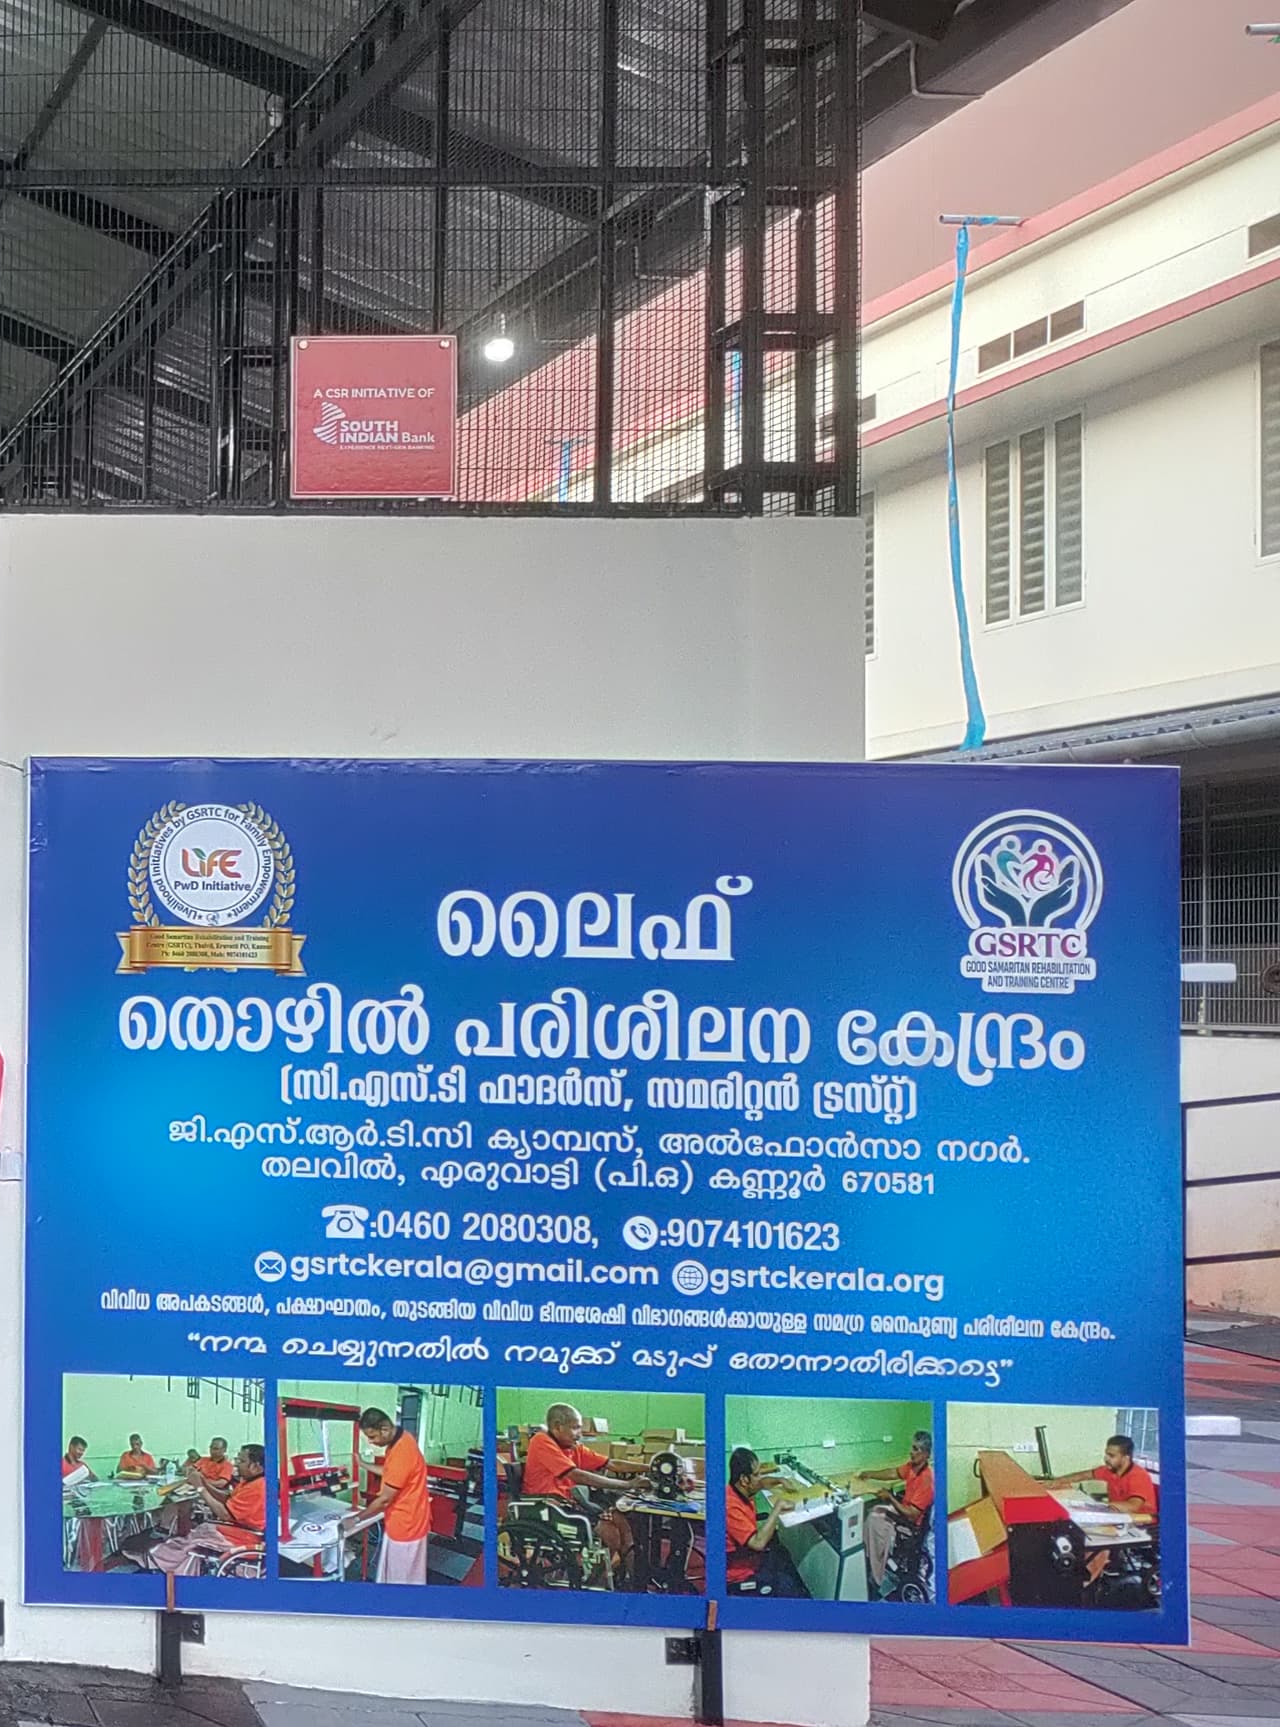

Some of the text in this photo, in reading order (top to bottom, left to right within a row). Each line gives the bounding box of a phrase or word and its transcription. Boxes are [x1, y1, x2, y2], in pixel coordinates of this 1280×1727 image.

[313, 388, 435, 398] A CSR INITIATIVE OF
[340, 420, 398, 431] SOUTH
[340, 432, 435, 443] INDIAN Bank
[186, 807, 222, 821] GSRTC
[224, 808, 241, 822] for
[240, 817, 268, 848] Family
[174, 881, 251, 891] PwD Initiative
[436, 875, 753, 962] ലൈഫ്
[975, 932, 1082, 958] GSRTC
[966, 961, 1090, 974] GOOD SAMARITAN REHABILITATION
[988, 976, 1069, 989] AND TRAINING CENTRE
[118, 981, 1086, 1087] തൊഴിൽ പരിശീലന കേന്ദ്രം
[647, 1071, 799, 1121] സമരിറ്റൻ
[659, 1129, 921, 1162] അൽഫോൻസാ
[936, 1136, 1030, 1164] നഗർ.
[261, 1153, 405, 1186] തലവിൽ,
[420, 1157, 579, 1190] എരുവാട്ടി
[708, 1165, 825, 1200] കണ്ണൂർ
[842, 1172, 936, 1195] 670581
[370, 1211, 840, 1251] :0460 2080308, :9074101623
[291, 1252, 944, 1300] gsrtckerala@gmail.com gsrtckerala.org
[101, 1290, 150, 1311] വിവിധ
[482, 1300, 533, 1322] വിവിധ
[539, 1301, 626, 1326] ഭിന്നശേഷി
[963, 1314, 1044, 1338] പരിശീലന
[503, 1340, 621, 1373] നമുക്ക്
